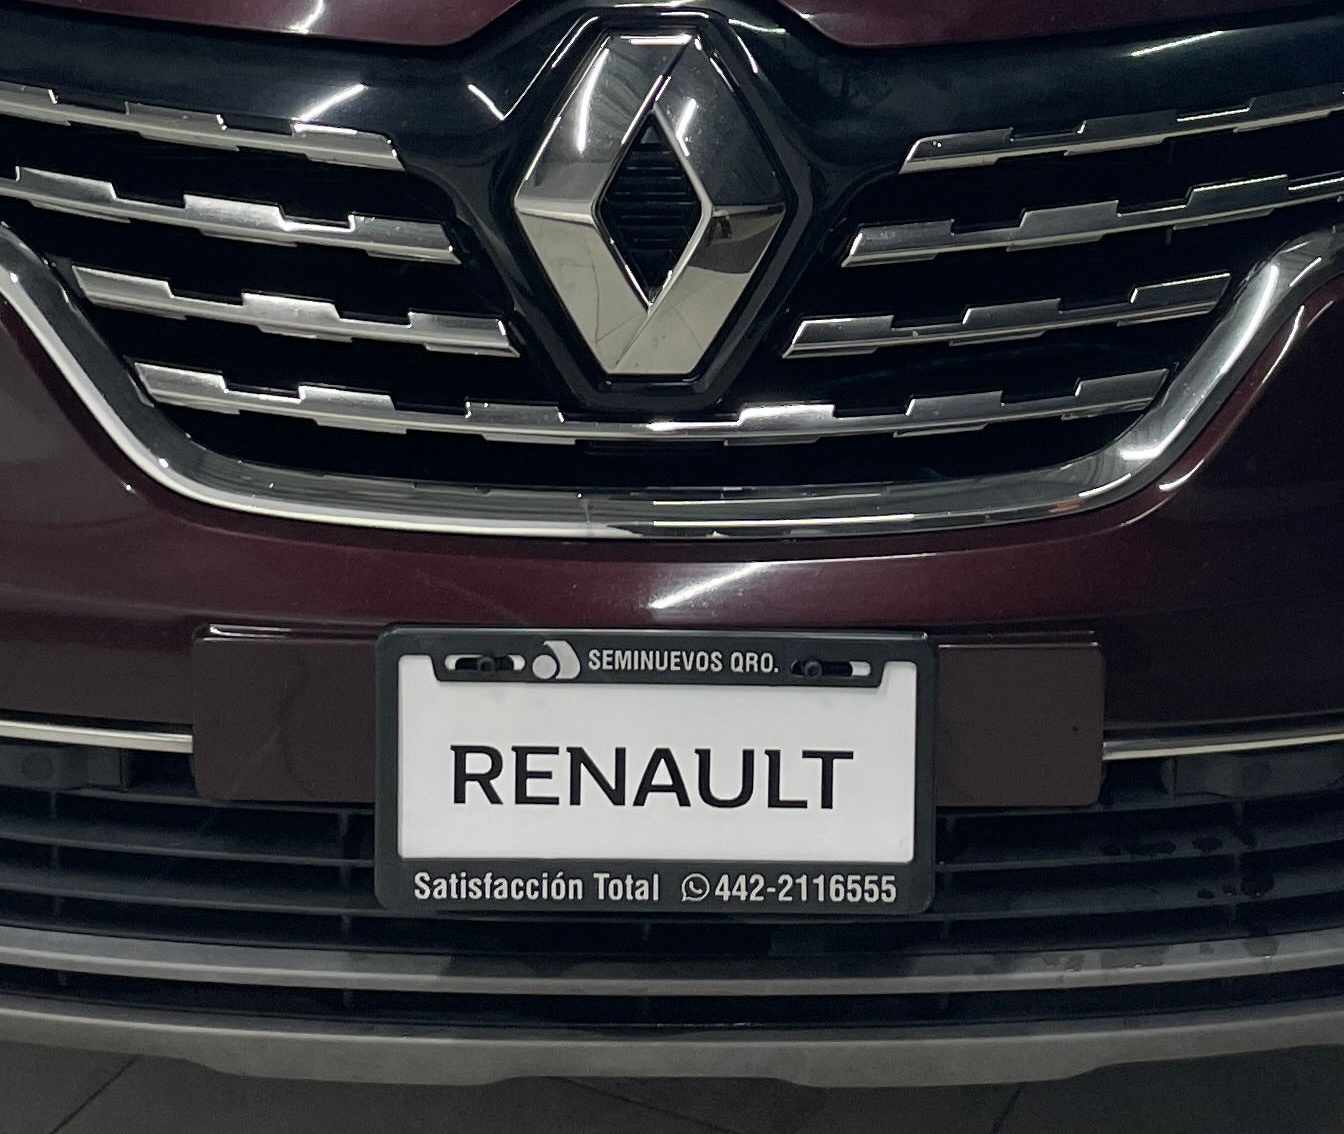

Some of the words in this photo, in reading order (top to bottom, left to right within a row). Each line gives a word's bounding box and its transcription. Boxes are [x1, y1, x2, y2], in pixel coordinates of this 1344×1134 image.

[588, 649, 723, 672] SEMINUEVOS
[730, 651, 779, 674] QRO.
[450, 744, 854, 810] RENAULT
[414, 871, 583, 901] Satisfacción
[592, 872, 659, 901] Total
[714, 873, 897, 903] 442-2116555
